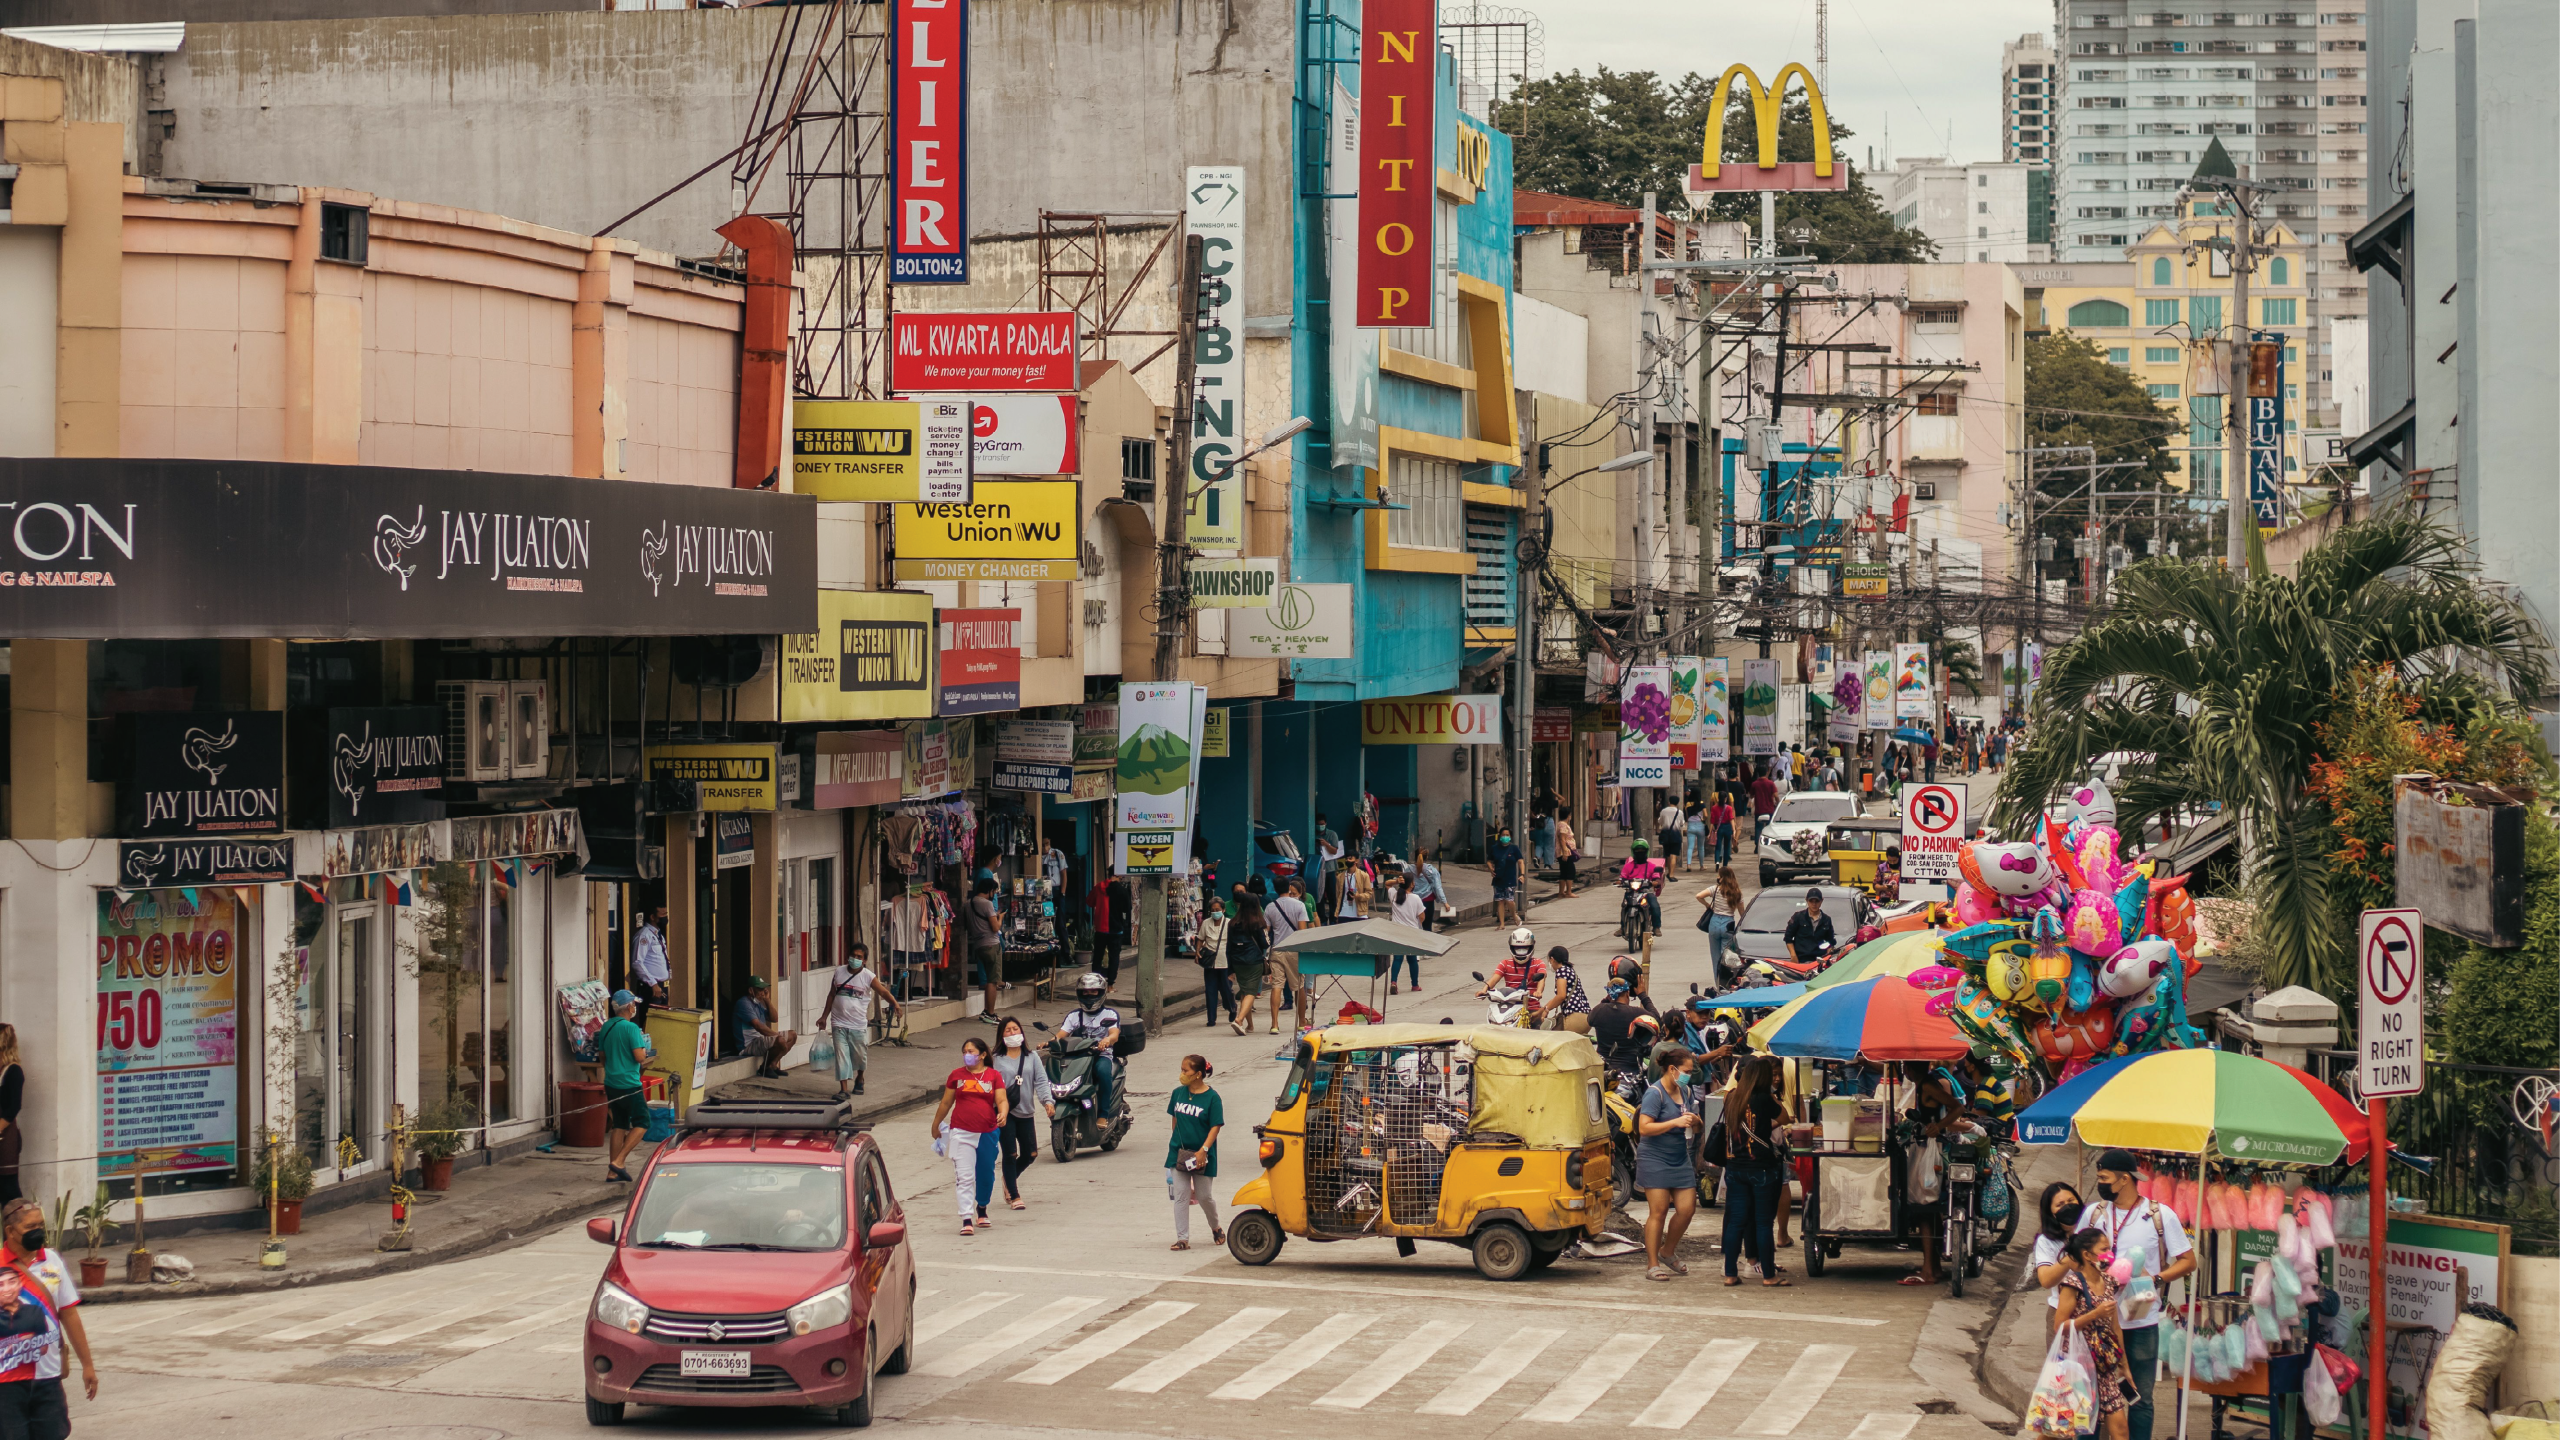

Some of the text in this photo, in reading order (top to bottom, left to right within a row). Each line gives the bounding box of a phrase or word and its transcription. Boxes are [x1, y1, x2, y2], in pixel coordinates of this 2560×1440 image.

[904, 0, 949, 246] LIER
[896, 258, 963, 275] BOLTON-2
[899, 323, 1072, 357] ML KWARTA PADALA
[924, 364, 1047, 379] We move your money fast!
[933, 405, 958, 416] eBiz
[804, 441, 854, 452] UNION
[926, 449, 963, 457] changer
[973, 440, 1024, 453] eyGram
[2256, 397, 2278, 519] BUANA
[793, 462, 904, 474] ONEY TRANSFER
[927, 467, 963, 475] payment
[928, 483, 962, 491] loading
[930, 490, 961, 498] center
[915, 502, 1011, 519] Western
[947, 520, 1061, 542] Union WU
[437, 510, 590, 581] JAY JUATON
[1189, 536, 1239, 544] PAWNSHOP, INC.
[674, 525, 773, 587] JAY JUATON
[925, 563, 1049, 578] MONEY CHANGER
[1844, 566, 1886, 576] CHOICE
[36, 571, 117, 587] NAILSPA
[1850, 580, 1881, 590] MART
[787, 628, 820, 654] MONEY
[843, 627, 892, 654] WESTERN
[788, 657, 835, 684] TRANSFER
[857, 656, 891, 682] UNION
[1363, 701, 1498, 735] UNITOP
[373, 734, 444, 777] JAY JUATON
[653, 759, 719, 770] WESTERN
[1006, 764, 1060, 777] MEN'S JEWELRY
[673, 769, 718, 779] UNION
[1625, 767, 1664, 779] NCCC
[995, 773, 1017, 787] GOLD
[1017, 775, 1046, 789] REPAIR
[1047, 777, 1070, 791] SHOP
[702, 787, 763, 799] TRANSFER
[143, 788, 277, 828] JAY JUATON
[1127, 811, 1175, 824] Kadayawan
[1130, 834, 1172, 844] BOYSEN
[1903, 835, 1964, 853] NO PARKING
[172, 844, 287, 877] JAY JUATON
[1913, 868, 1948, 876] CTTMO
[97, 929, 233, 981] PROMO
[2382, 1012, 2403, 1033] NO
[2371, 1038, 2414, 1061] RIGHT
[2372, 1064, 2411, 1087] TURN
[2251, 1139, 2327, 1159] MICROMATIC
[2244, 1241, 2271, 1253] DAPAT
[2258, 1233, 2276, 1245] MAY
[2338, 1263, 2356, 1279] Do
[2387, 1273, 2418, 1288] eave
[2422, 1278, 2451, 1293] your
[2338, 1279, 2433, 1308] Maxim Penalty:
[2410, 1308, 2425, 1321] or
[684, 1358, 747, 1369] 0701-663693
